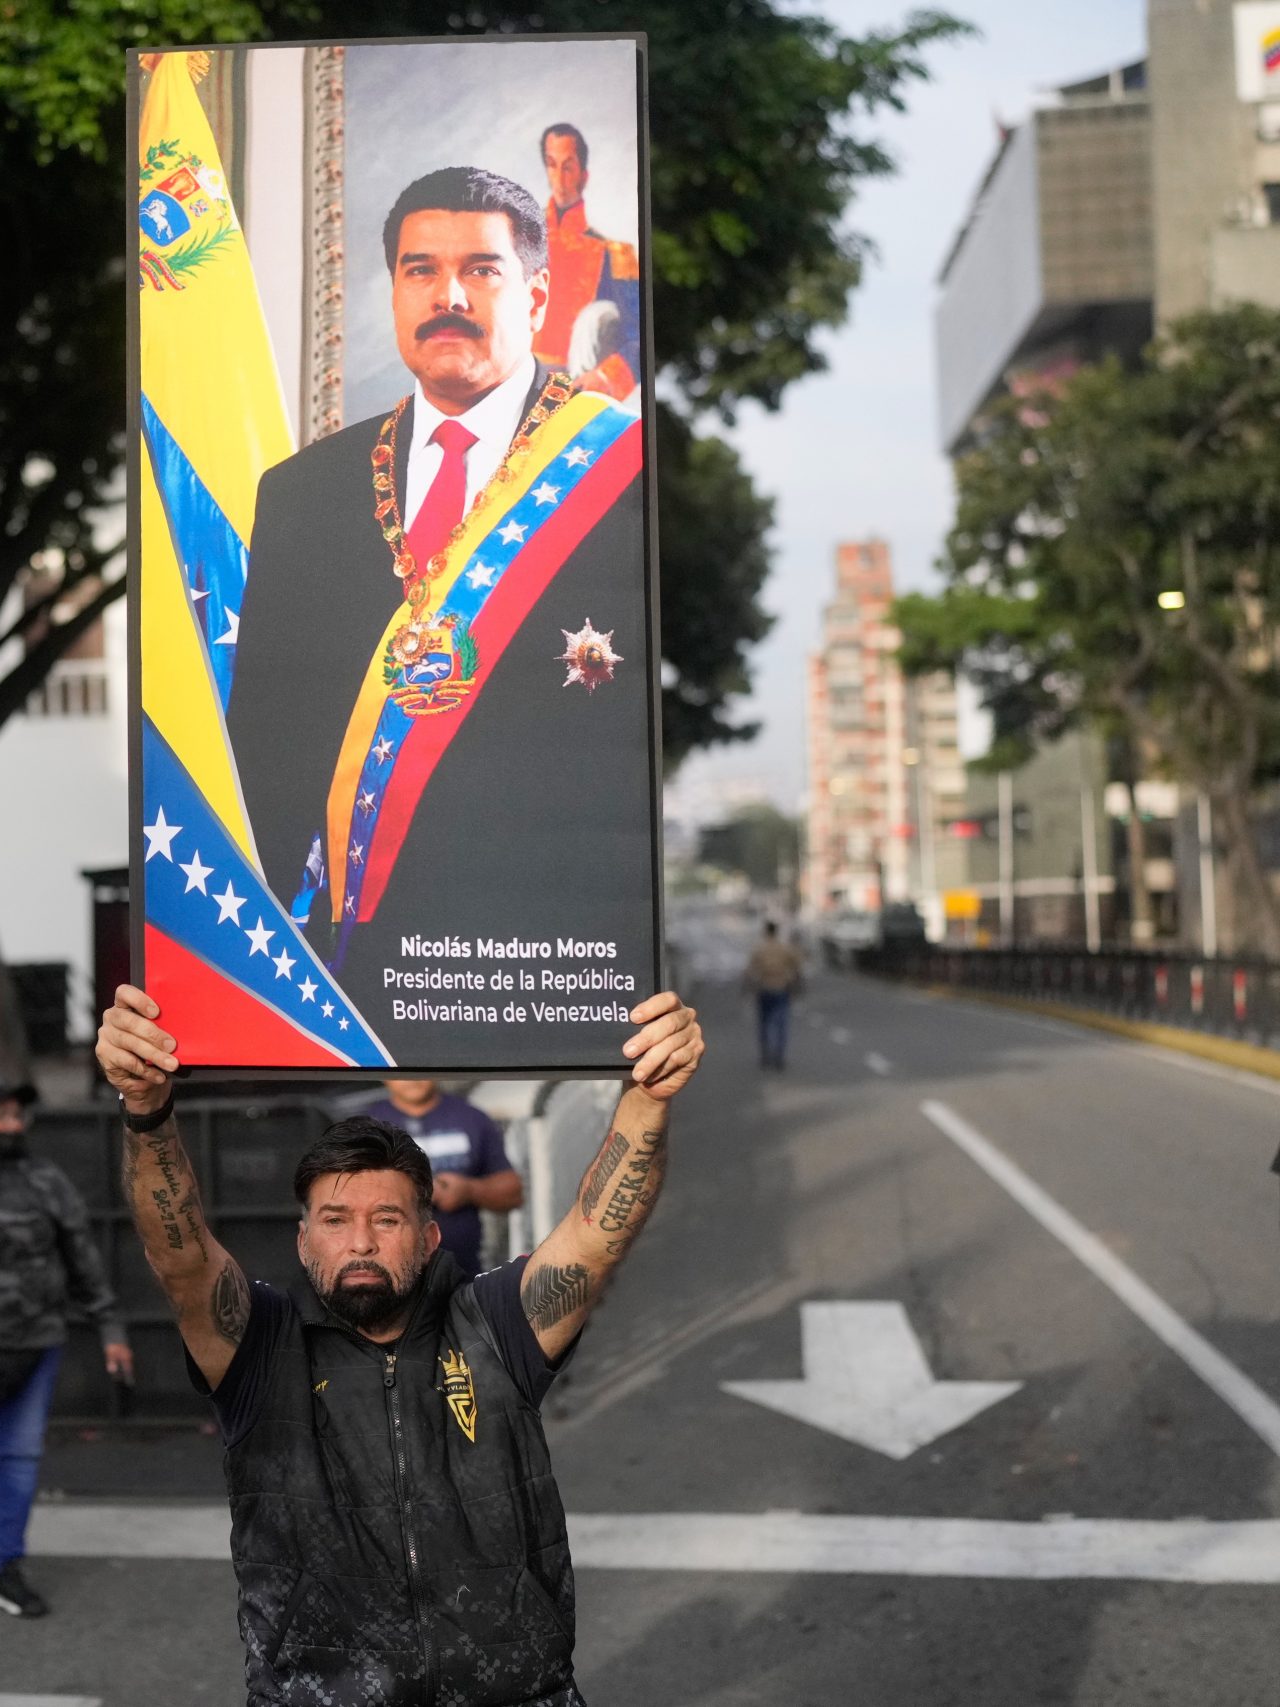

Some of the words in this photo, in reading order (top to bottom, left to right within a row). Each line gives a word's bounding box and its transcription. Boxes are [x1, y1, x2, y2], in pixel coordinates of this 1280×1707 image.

[401, 934, 472, 958] Nicolás
[476, 937, 552, 959] Maduro
[556, 938, 617, 959] Moros
[383, 967, 486, 991] Presidente
[489, 969, 515, 991] de
[519, 969, 535, 991] la
[541, 968, 635, 995] República
[392, 999, 498, 1023] Bolivariana
[502, 1001, 527, 1023] de
[531, 1001, 629, 1023] Venezuela
